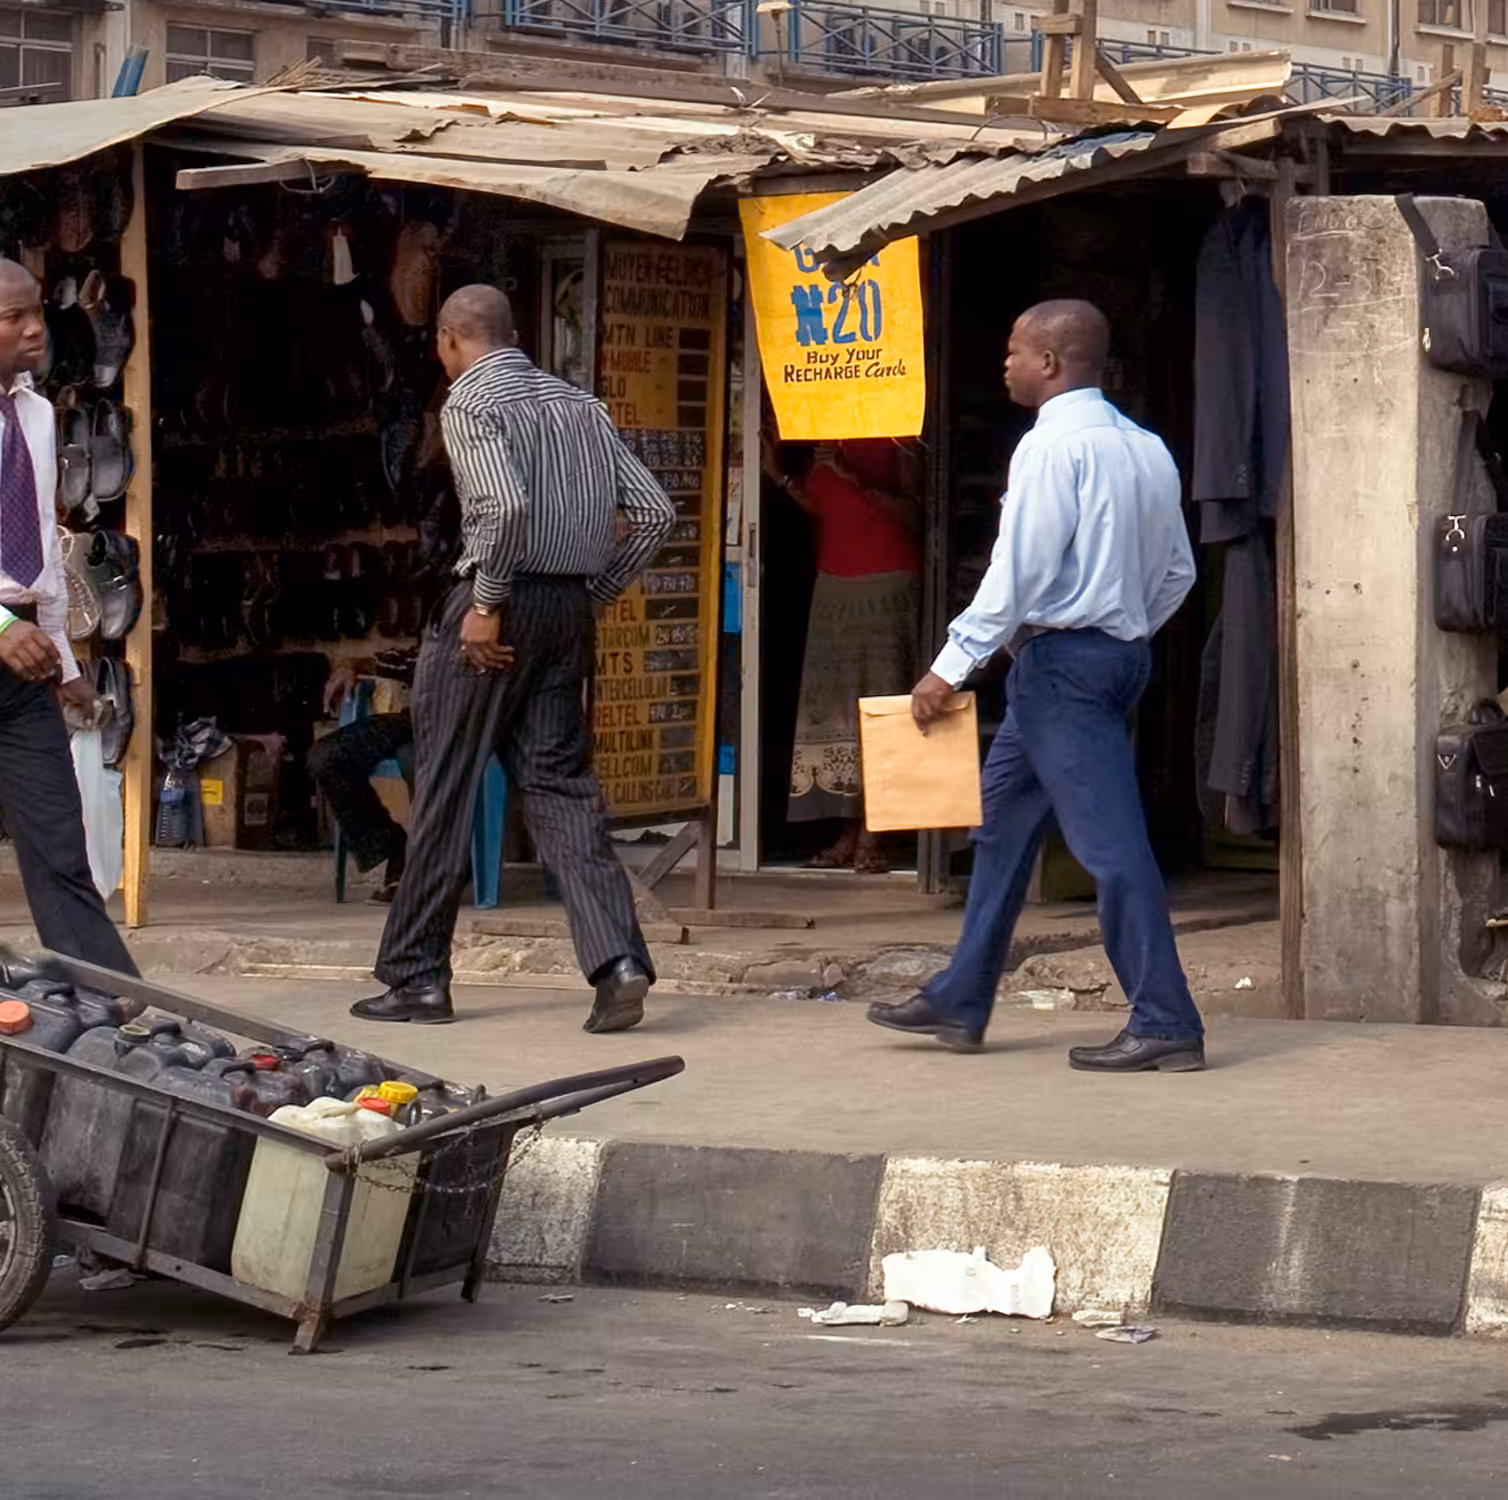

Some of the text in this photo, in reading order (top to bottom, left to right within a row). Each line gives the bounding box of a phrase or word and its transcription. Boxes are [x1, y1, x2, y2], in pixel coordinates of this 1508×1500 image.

[806, 348, 883, 366] Buy Your
[784, 364, 861, 383] RECHARGE
[596, 676, 670, 701] NTERCELLULAR
[599, 755, 652, 779] ELLCOM
